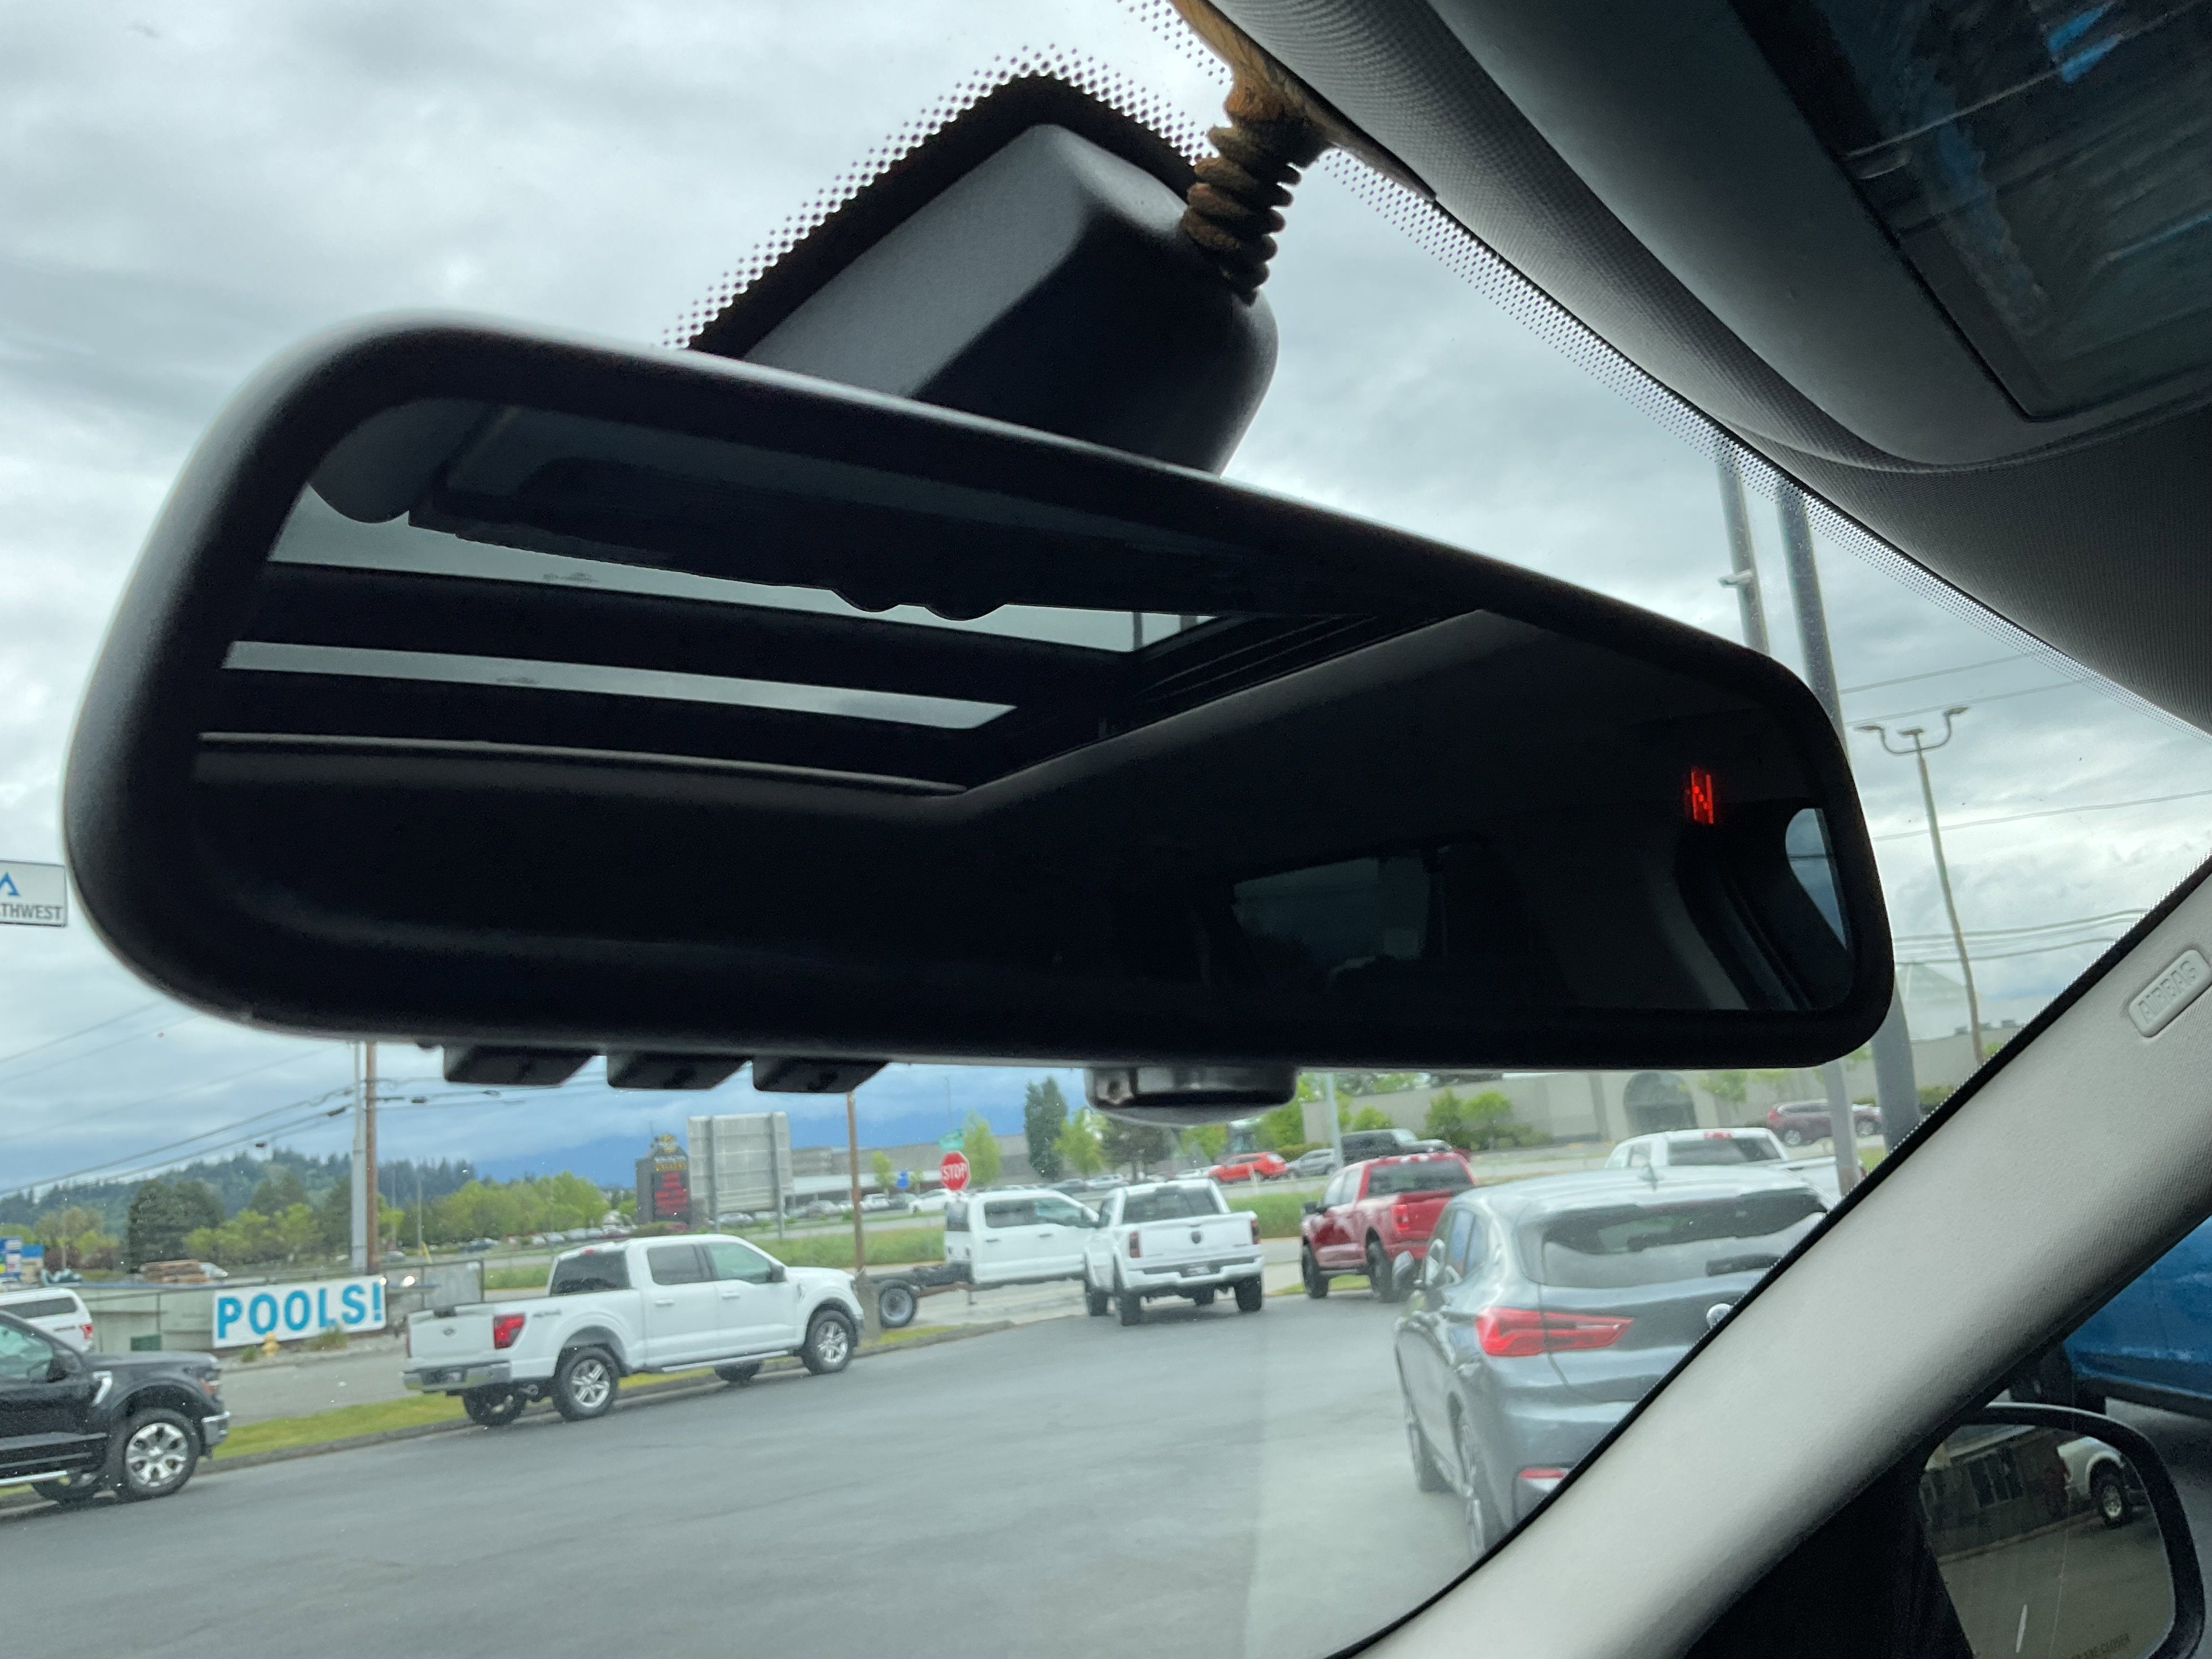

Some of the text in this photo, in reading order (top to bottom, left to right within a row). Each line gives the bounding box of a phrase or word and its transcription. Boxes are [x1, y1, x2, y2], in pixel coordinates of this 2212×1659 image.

[1691, 771, 1713, 824] N
[2137, 960, 2197, 1025] AIRBAG
[941, 1163, 967, 1181] STOP
[217, 1281, 382, 1339] POOLS!
